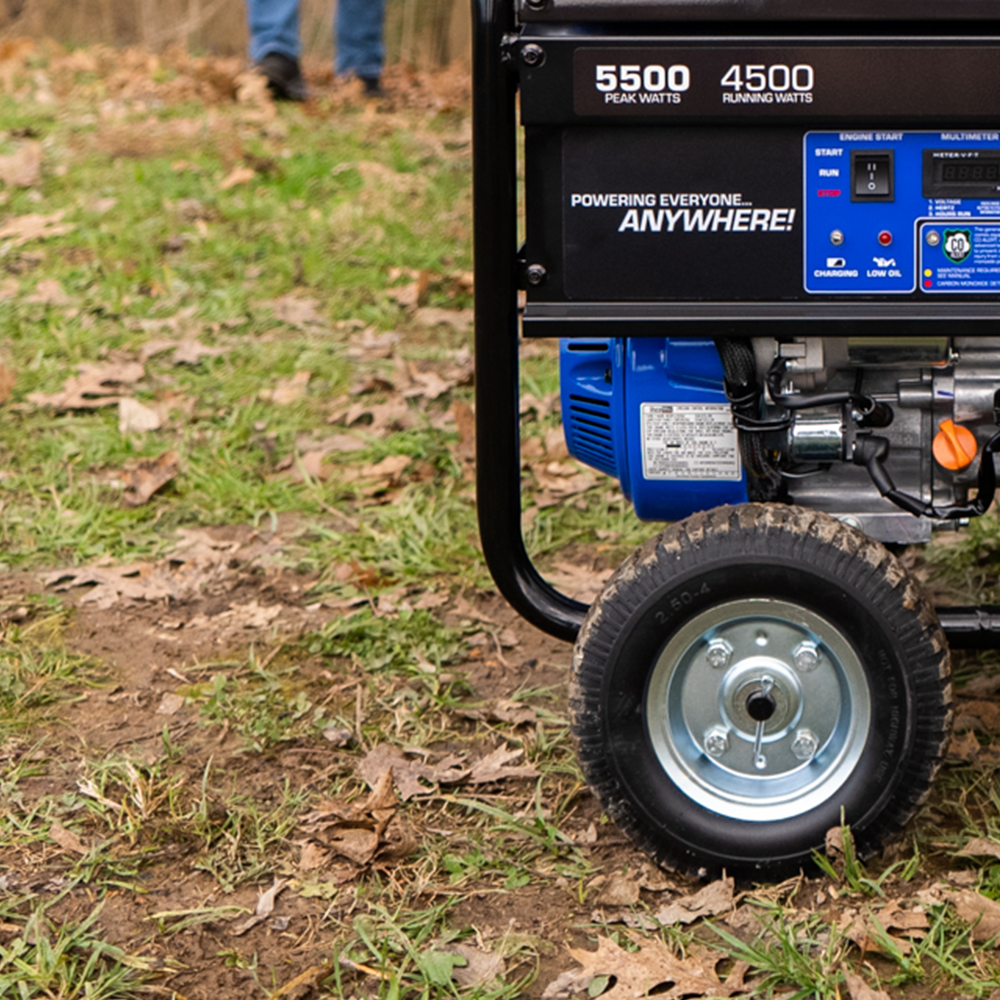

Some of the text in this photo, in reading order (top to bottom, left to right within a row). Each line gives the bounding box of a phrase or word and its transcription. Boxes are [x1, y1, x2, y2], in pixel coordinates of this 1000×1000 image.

[595, 64, 691, 92] 5500
[720, 64, 815, 92] 4500
[604, 92, 682, 104] PEAK WATTS
[722, 92, 814, 104] RUNNING WATTS
[839, 133, 904, 141] ENGINE START
[940, 133, 1000, 141] MULTIMETER
[814, 148, 844, 157] START
[818, 168, 840, 177] RUN
[817, 189, 842, 198] STOP
[571, 193, 753, 207] POWERING EVERYONE...
[617, 208, 796, 232] ANYWHERE!
[951, 238, 965, 251] CO
[813, 269, 859, 278] CHARGING
[866, 269, 902, 278] LOW OIL
[654, 581, 712, 625] 2.50-4
